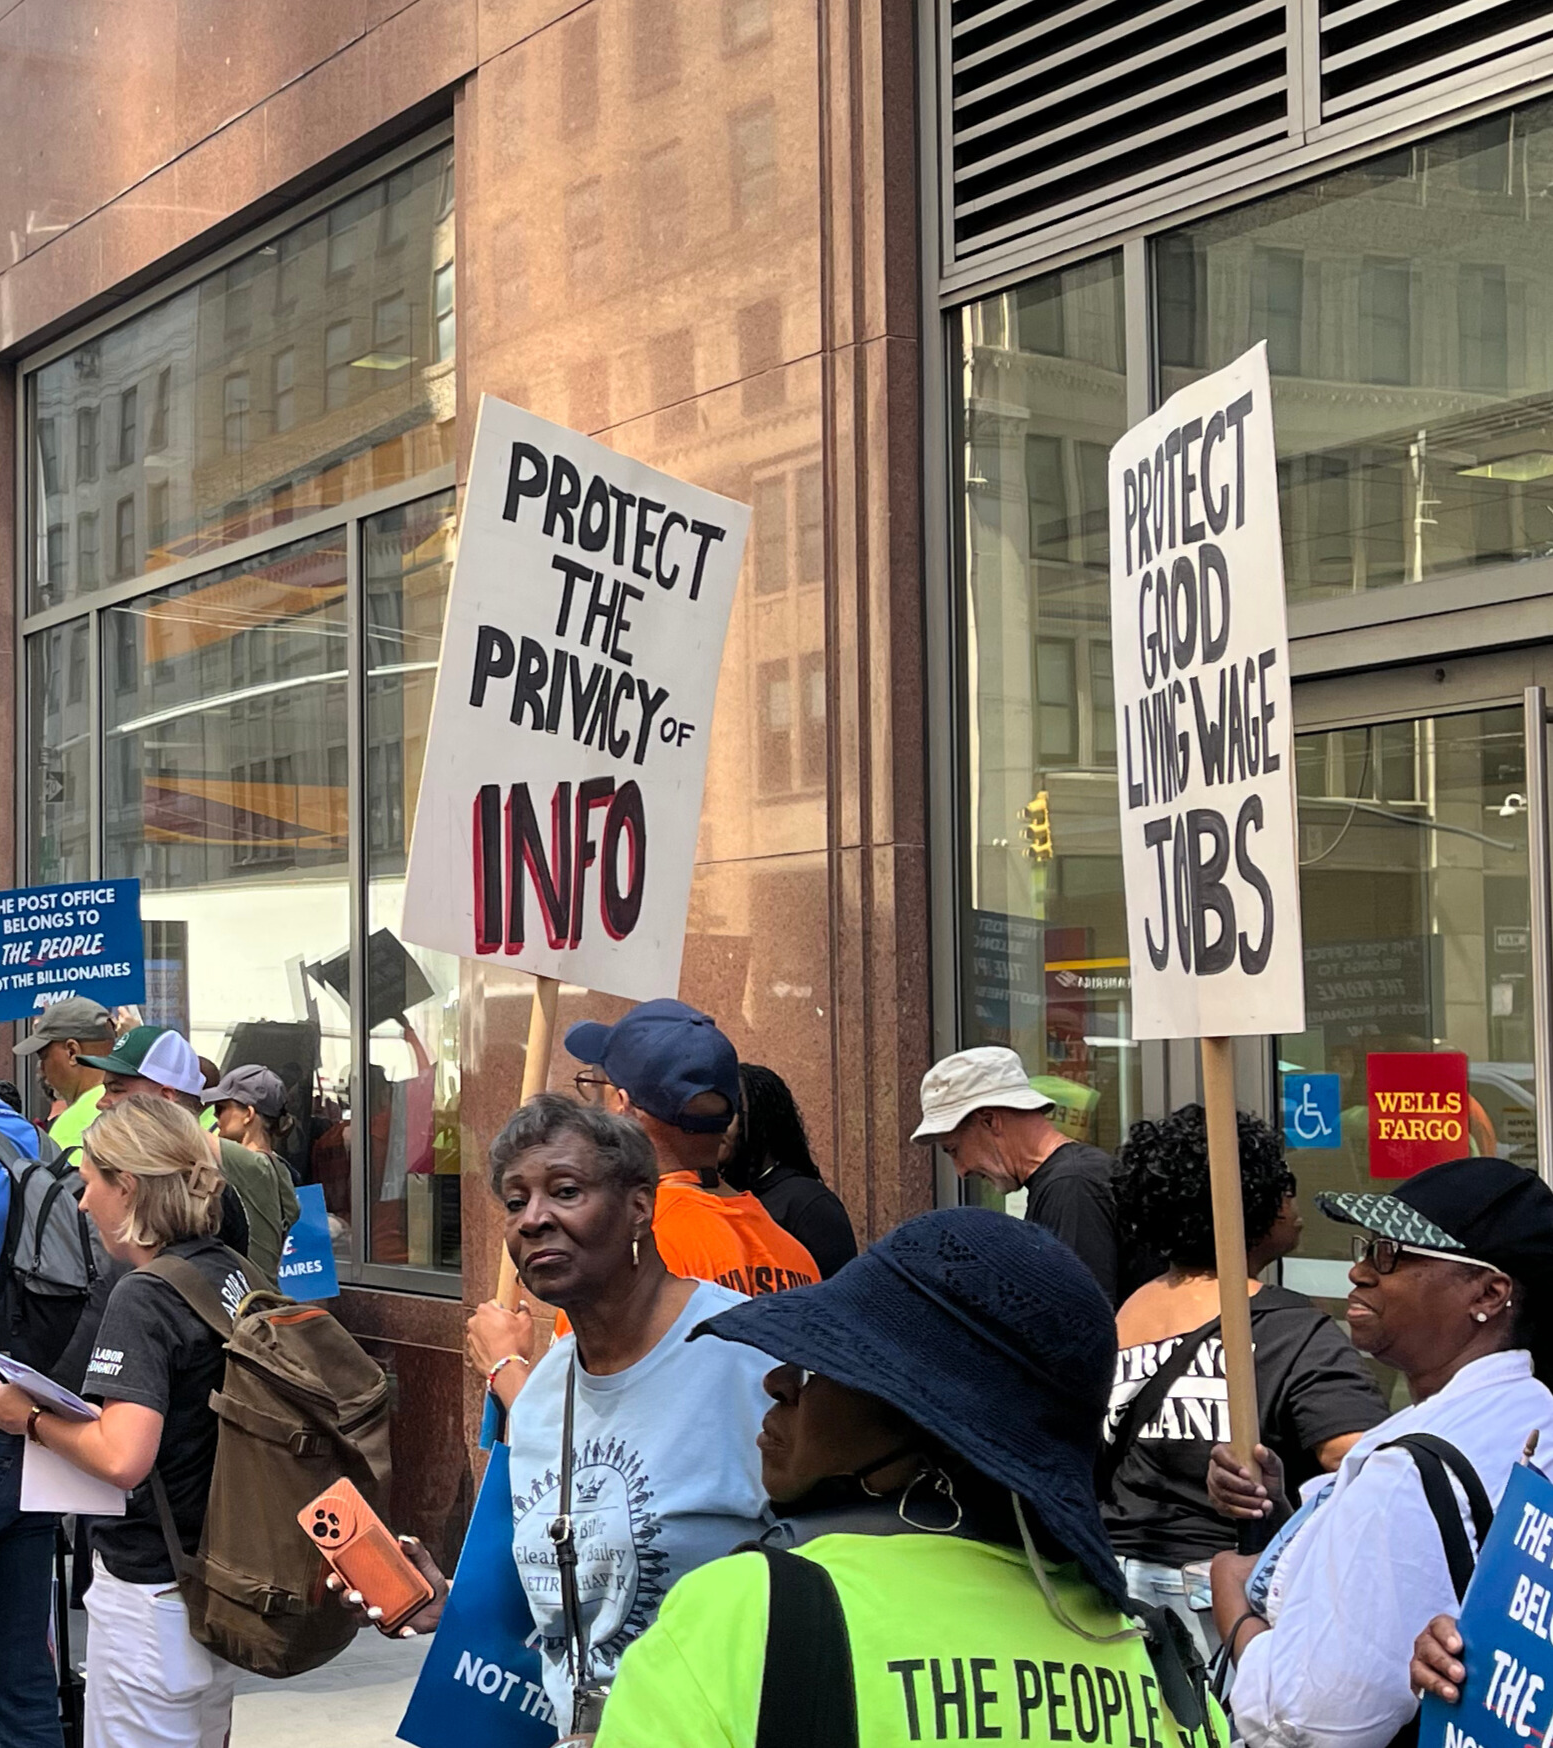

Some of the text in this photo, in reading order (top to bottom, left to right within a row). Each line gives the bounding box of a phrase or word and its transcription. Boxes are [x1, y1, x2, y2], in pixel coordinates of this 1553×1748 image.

[502, 441, 726, 601] PROTECT
[1123, 390, 1253, 577] PROTECT
[552, 554, 645, 666] THE
[1138, 542, 1231, 689] GOOD
[469, 625, 695, 766] PRIVACY OF
[1124, 648, 1282, 811] LIVING WAGE
[17, 893, 58, 912] POST
[61, 888, 115, 907] OFFICE
[473, 776, 646, 956] INFO
[1144, 794, 1275, 977] JOBS
[1, 932, 105, 966] THE PEOPLE
[3, 910, 100, 935] BELONGS TO
[11, 972, 34, 989] THE
[37, 962, 131, 984] BILLIONAIRES
[1375, 1092, 1462, 1114] WELLS
[1378, 1119, 1462, 1141] FARGO
[279, 1260, 323, 1278] NAIRES
[1513, 1501, 1553, 1564] THE
[453, 1650, 521, 1702] NOT
[887, 1657, 1163, 1748] THE PEOPLE
[1486, 1649, 1545, 1738] THE
